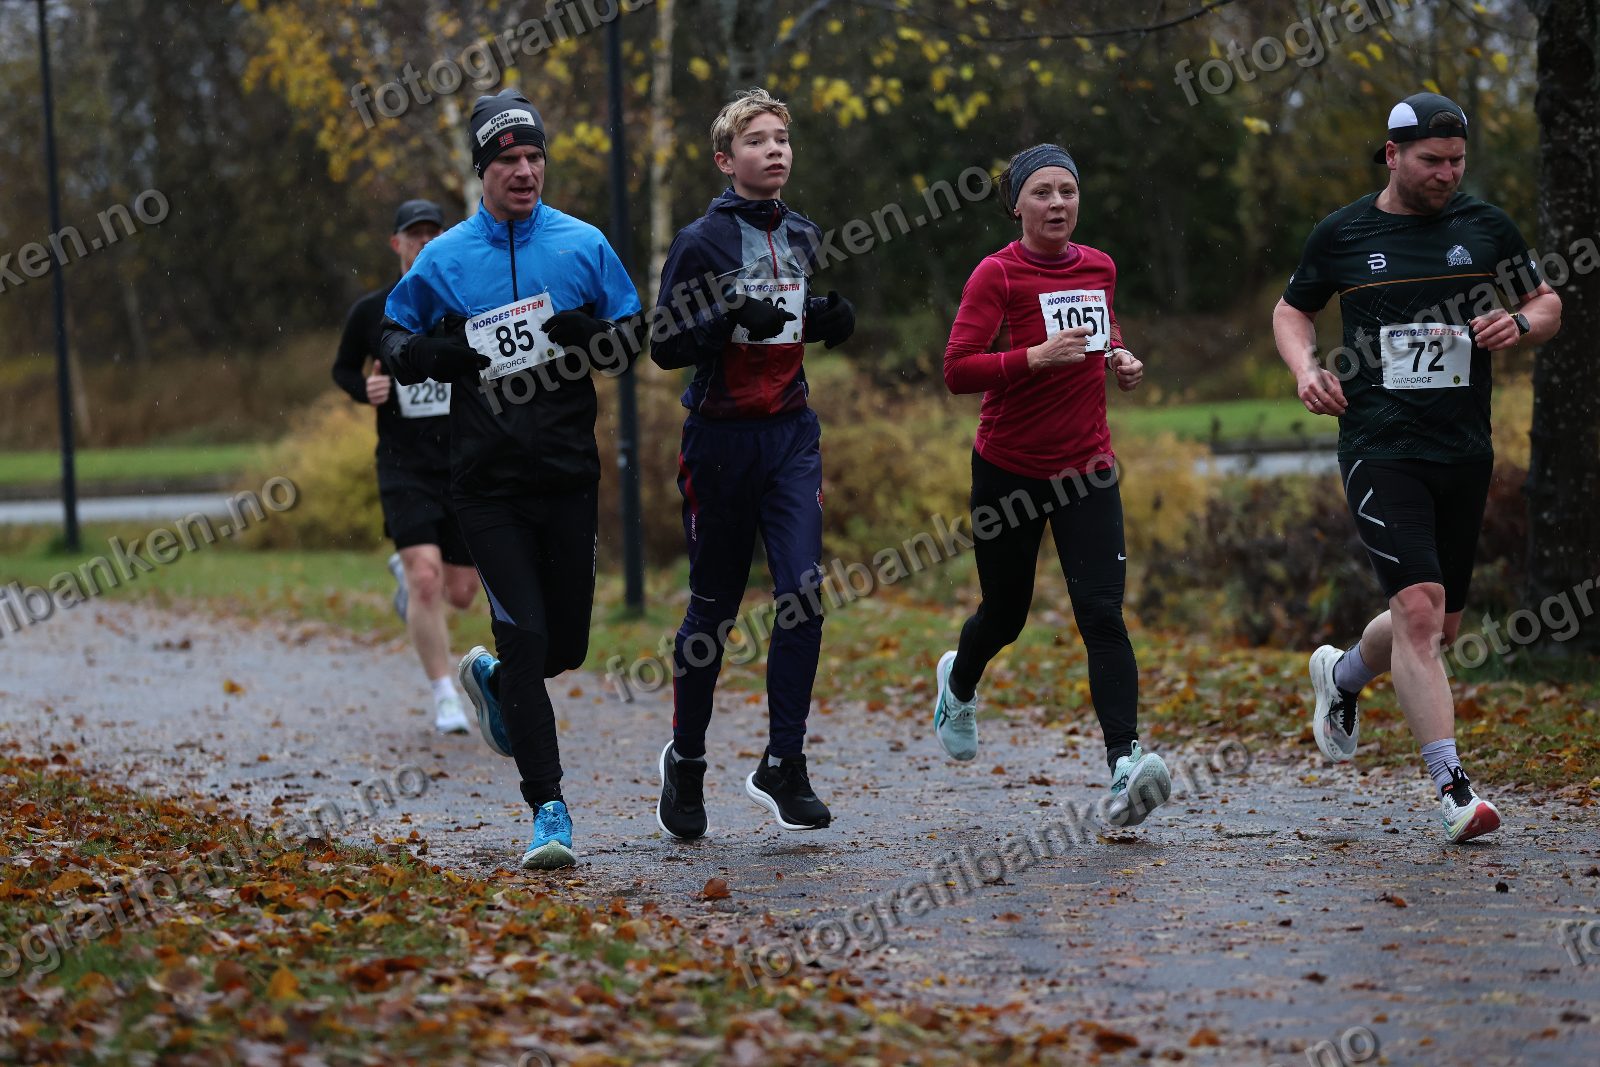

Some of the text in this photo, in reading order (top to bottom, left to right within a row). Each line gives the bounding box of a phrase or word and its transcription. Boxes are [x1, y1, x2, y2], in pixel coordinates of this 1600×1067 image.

[481, 116, 529, 142] Sportslager
[491, 112, 509, 125] Oslo
[1047, 294, 1102, 306] NORGESTESTEN
[472, 299, 544, 331] NORGESTESTEN
[1052, 306, 1105, 337] 1057
[495, 319, 535, 358] 85
[1407, 340, 1445, 373] 72
[407, 382, 448, 405] 228
